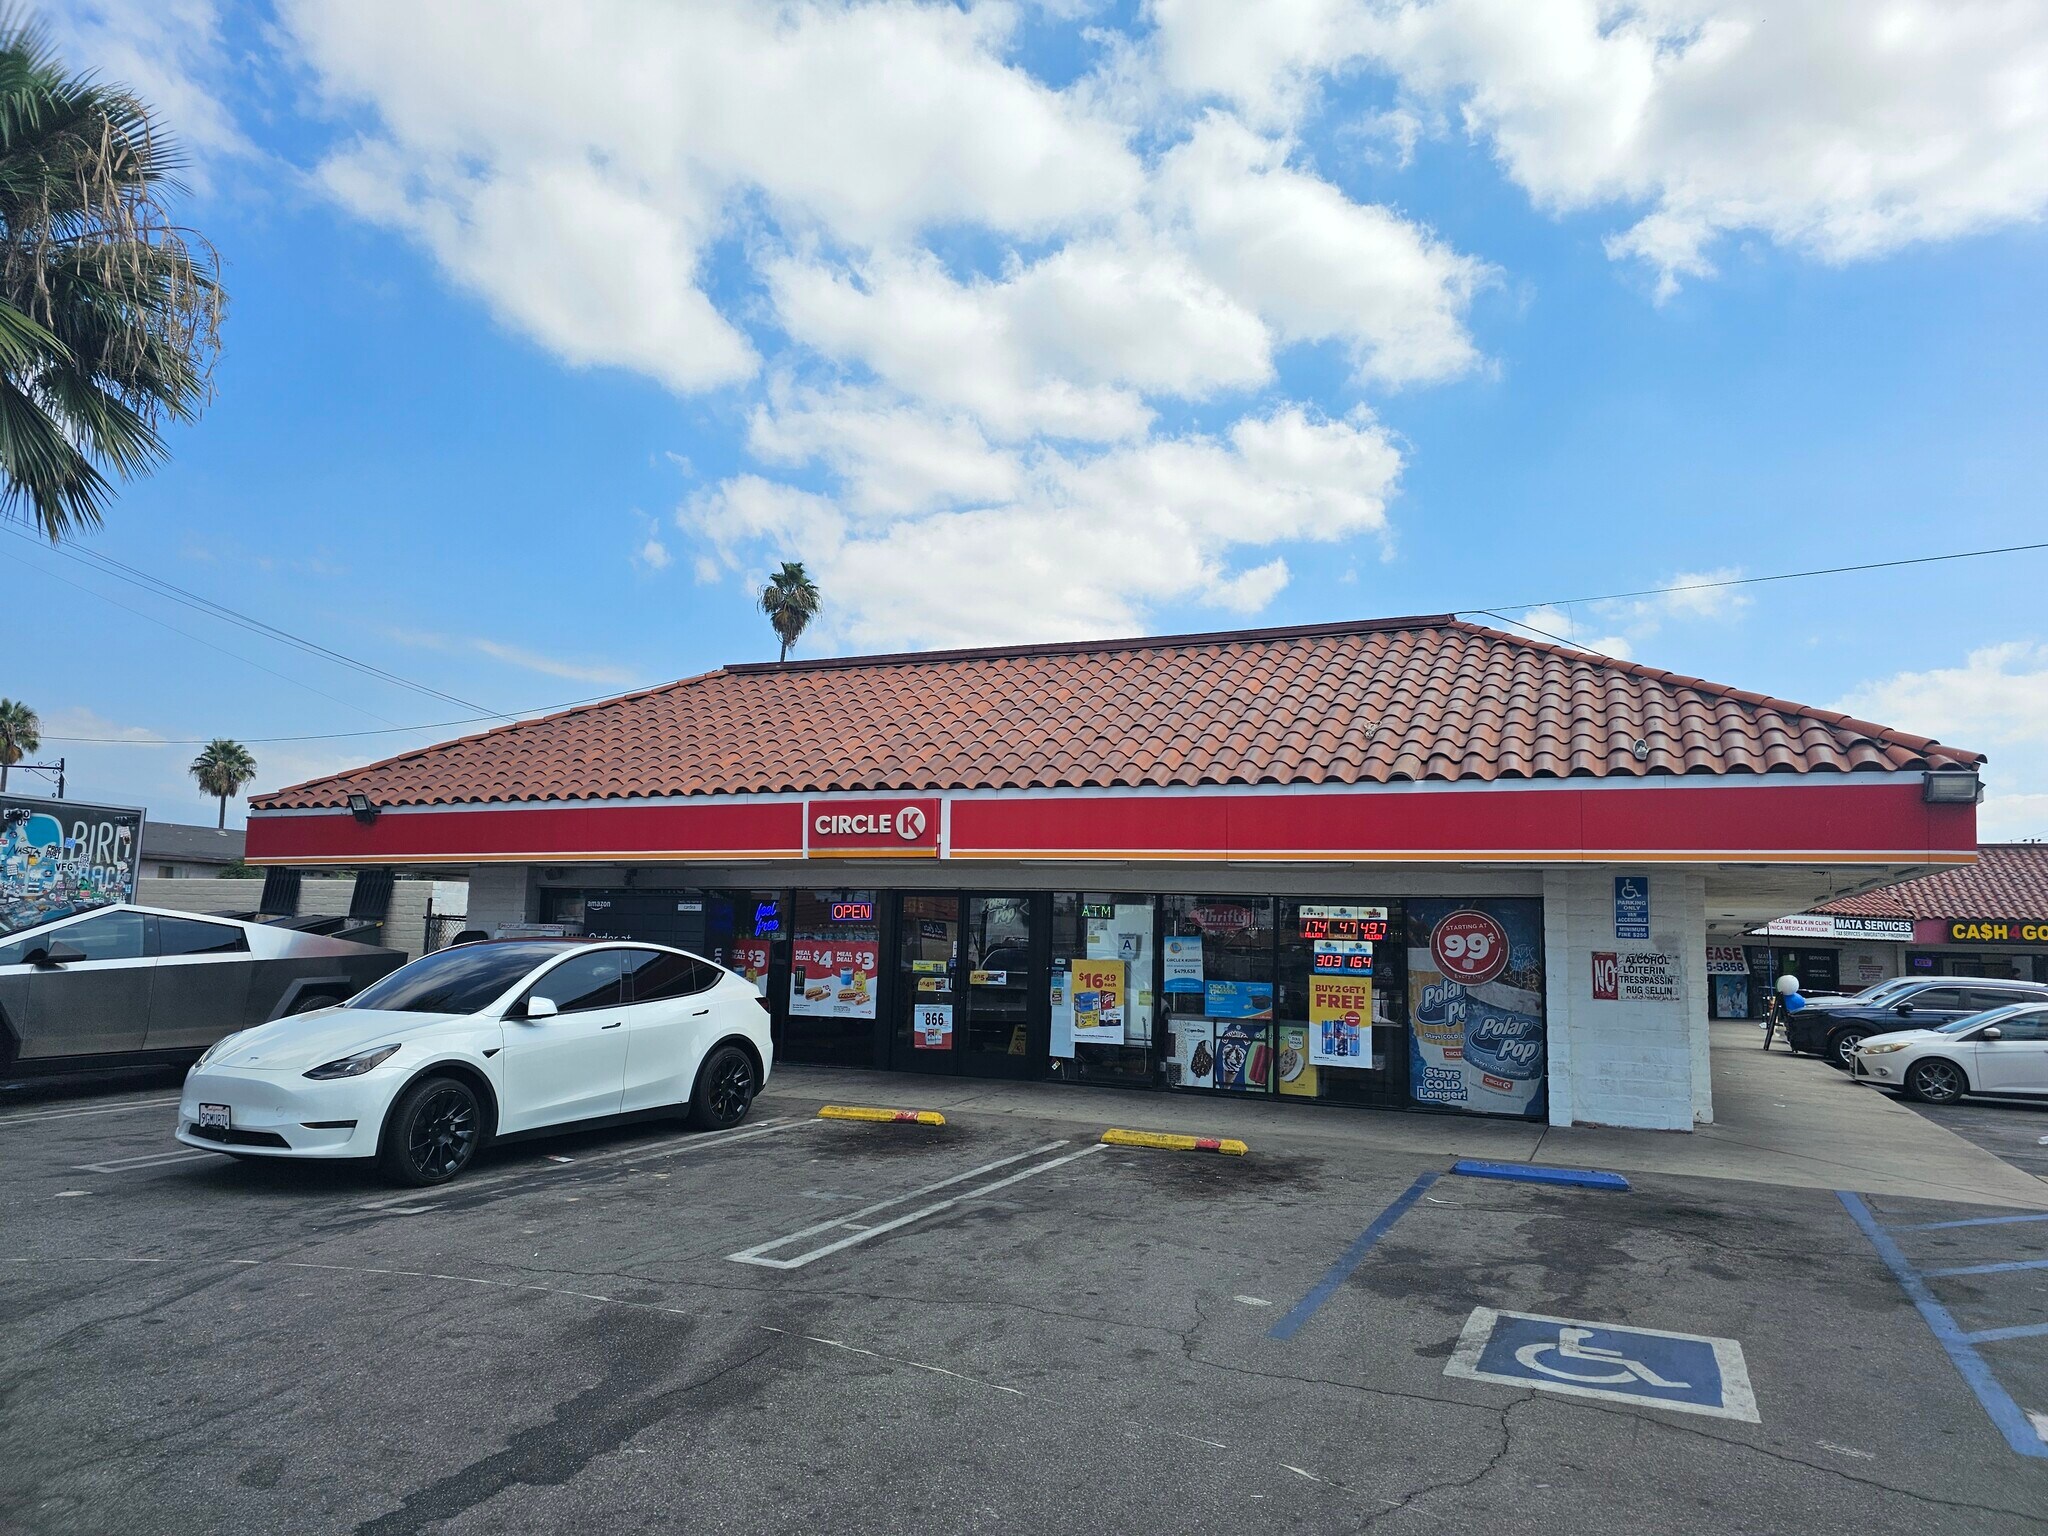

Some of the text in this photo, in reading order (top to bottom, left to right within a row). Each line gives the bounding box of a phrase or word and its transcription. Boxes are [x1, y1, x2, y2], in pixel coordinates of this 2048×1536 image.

[815, 809, 924, 838] CIRCLE K
[586, 901, 611, 909] amazon
[755, 901, 777, 921] feel
[834, 904, 871, 919] OPEN
[1082, 905, 1111, 918] ATM
[755, 918, 779, 936] free
[1305, 921, 1328, 932] 174
[1339, 922, 1357, 933] 47
[1360, 922, 1387, 934] 497
[1835, 918, 1912, 932] MATA SERVICES
[1952, 922, 2008, 941] CA$H
[2009, 924, 2020, 940] 4
[1122, 939, 1132, 950] A
[748, 949, 766, 968] $3
[813, 950, 833, 969] $4
[855, 951, 875, 970] $3
[1316, 955, 1342, 967] 303
[1349, 956, 1372, 968] 164
[1625, 955, 1670, 965] ALCOHOL
[1594, 959, 1616, 993] NO
[1315, 984, 1366, 994] BUY 2 GET 1
[1316, 993, 1365, 1010] FREE
[1448, 1001, 1466, 1023] Po
[1480, 1017, 1529, 1036] Polar
[1499, 1039, 1537, 1062] Pop
[1424, 1068, 1460, 1079] Stays
[1424, 1080, 1460, 1090] COLD
[1419, 1089, 1467, 1101] Longer!
